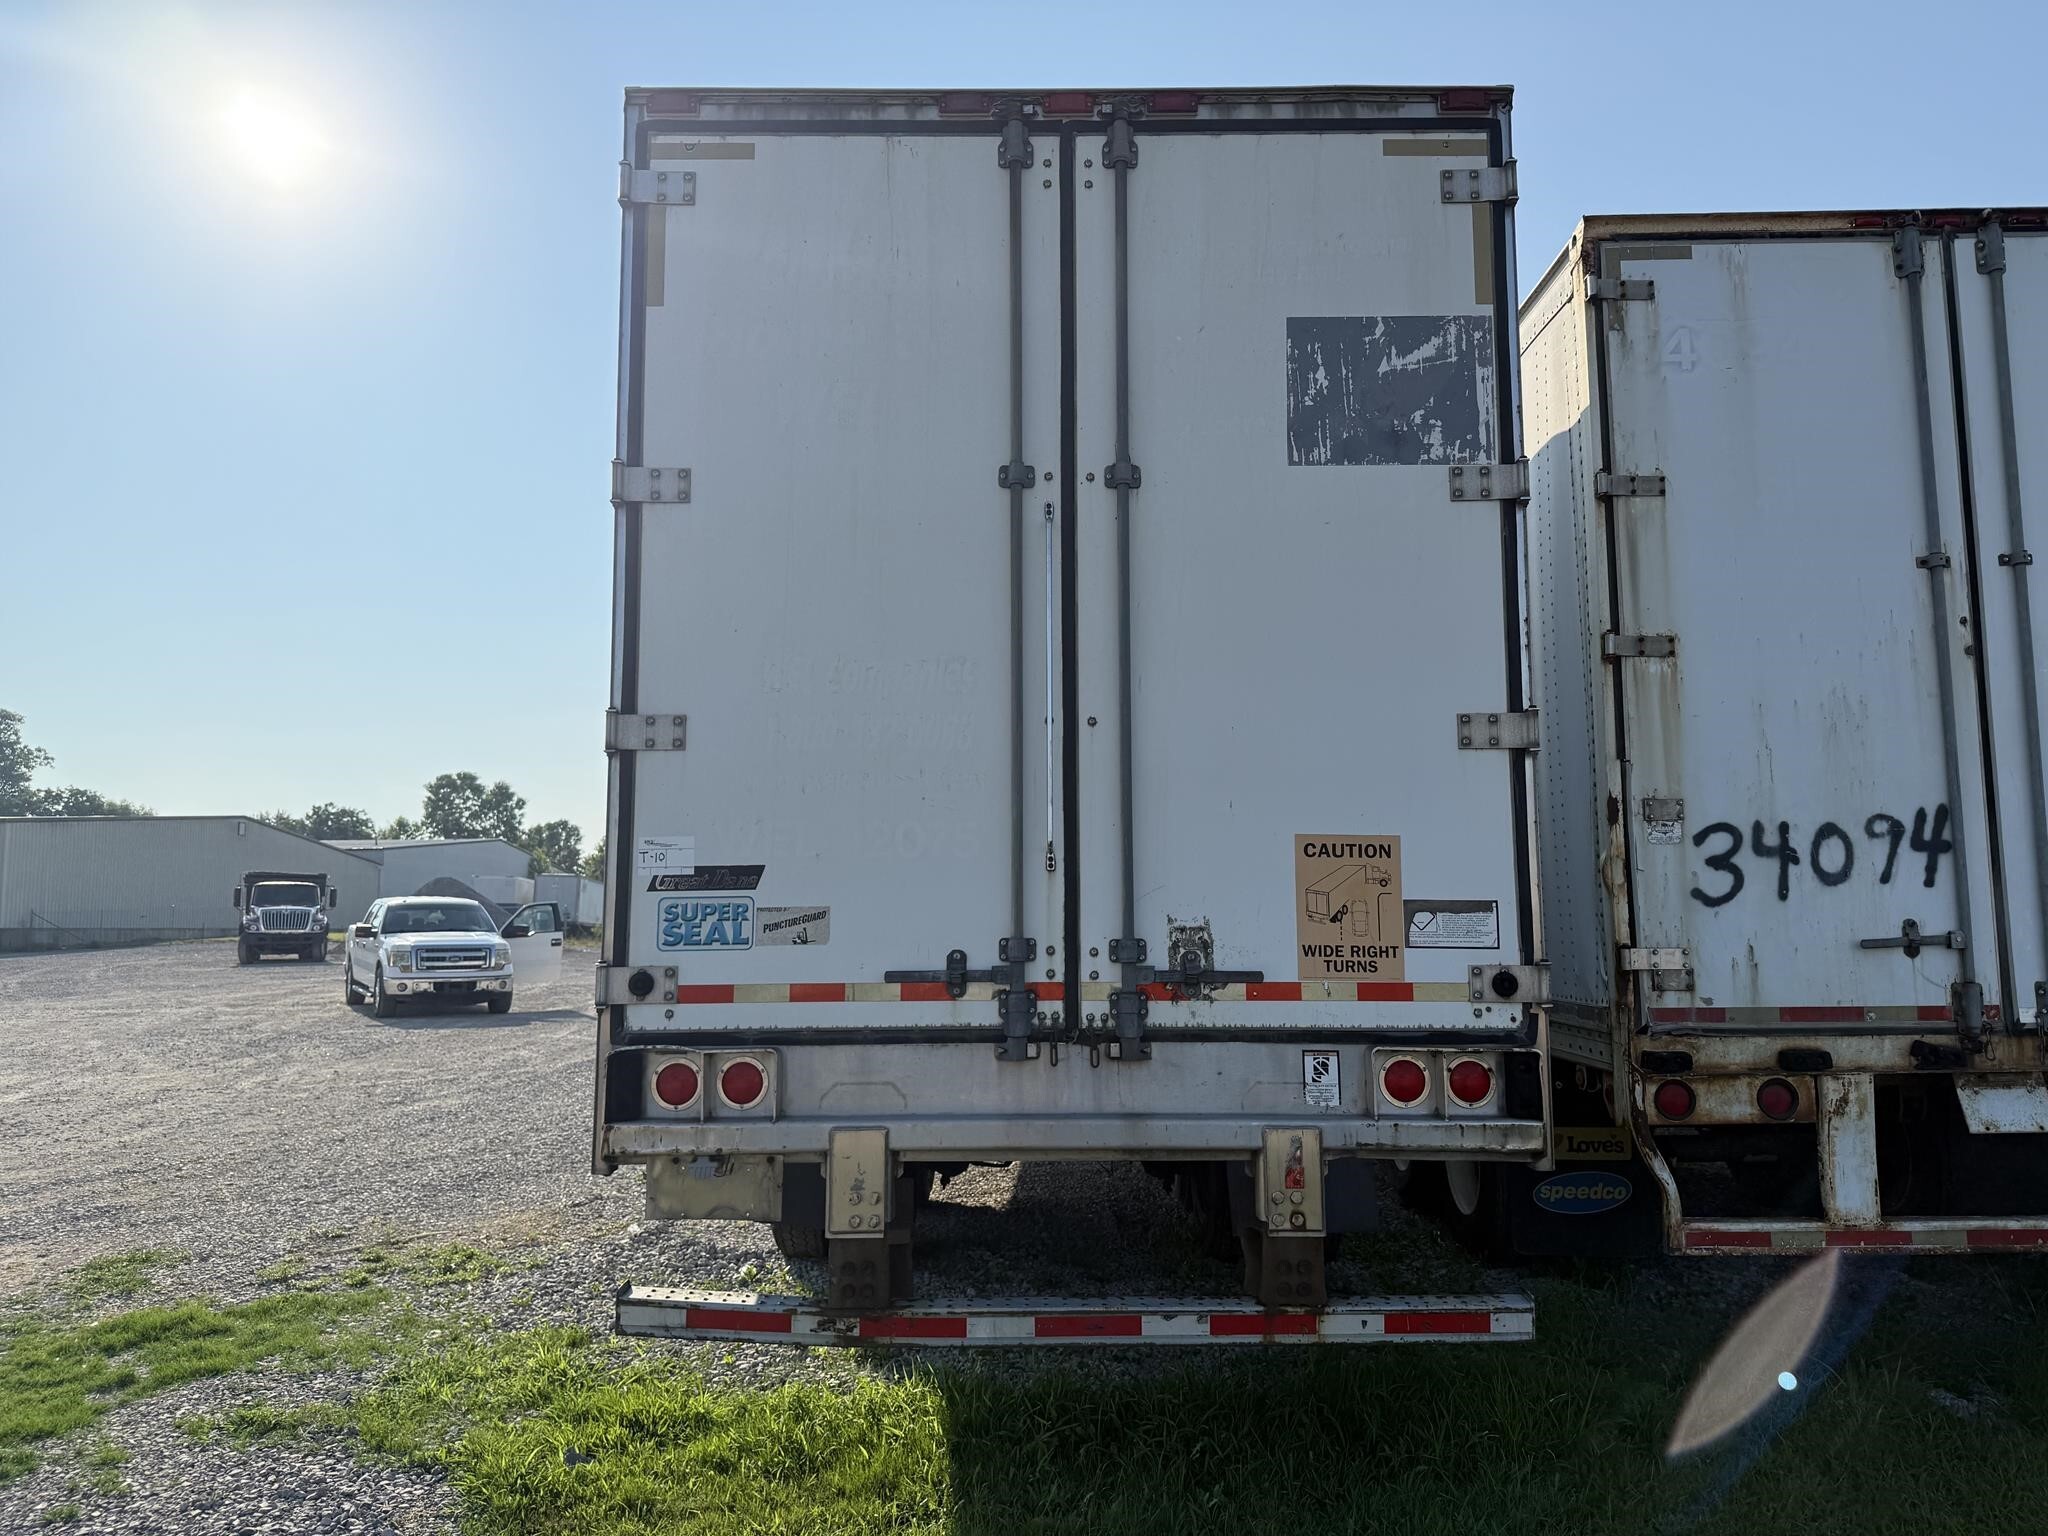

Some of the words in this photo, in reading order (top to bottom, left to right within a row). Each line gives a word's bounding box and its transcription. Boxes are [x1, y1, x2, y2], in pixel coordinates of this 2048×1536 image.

[639, 851, 666, 863] T-10
[1303, 842, 1392, 859] CAUTION
[1690, 803, 1953, 908] 34094
[663, 901, 750, 922] SUPER
[762, 910, 827, 934] PUNCTUREGUARD
[661, 920, 750, 946] SEAL
[1302, 945, 1347, 959] WIDE
[1350, 945, 1399, 959] RIGHT
[1323, 960, 1378, 973] TURNS
[1539, 1182, 1628, 1203] speedco
